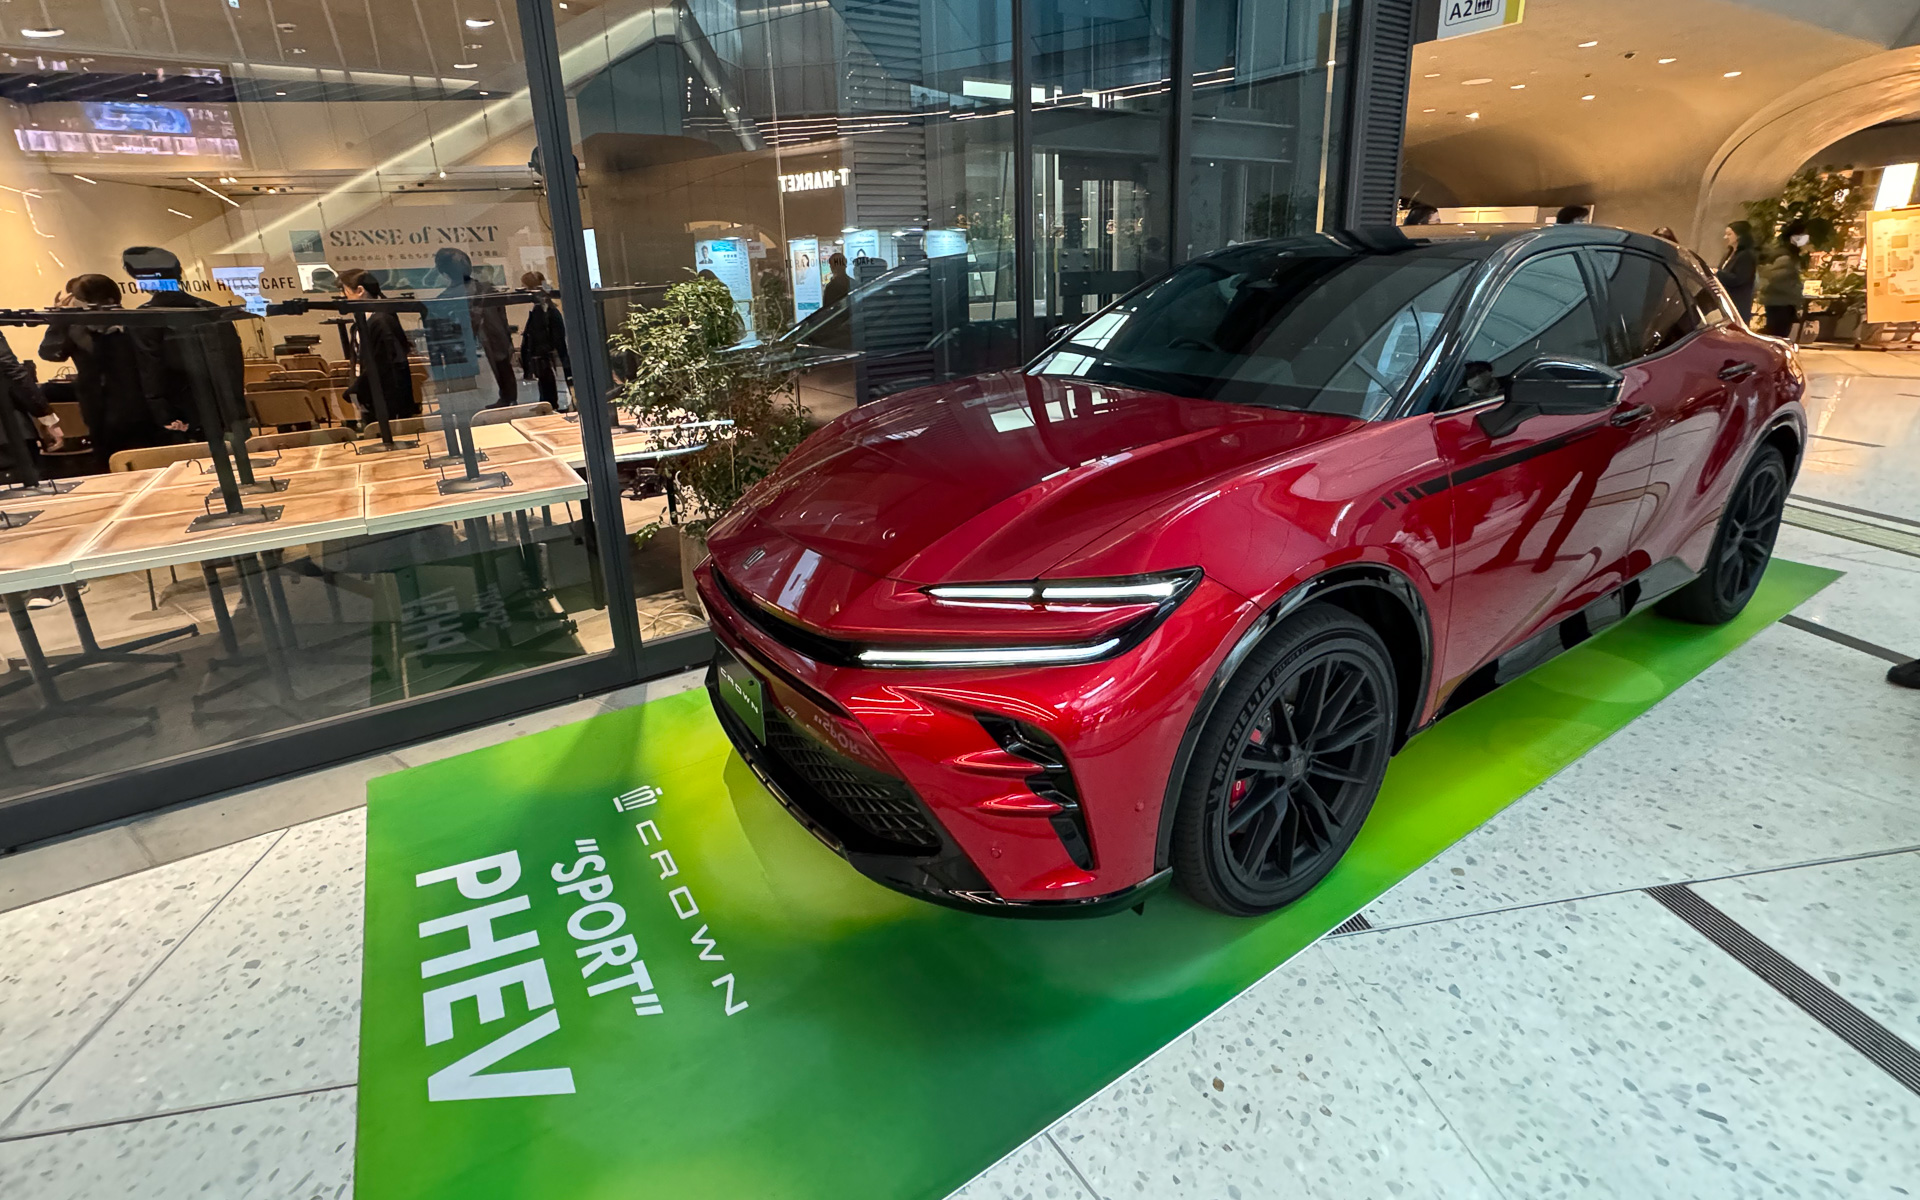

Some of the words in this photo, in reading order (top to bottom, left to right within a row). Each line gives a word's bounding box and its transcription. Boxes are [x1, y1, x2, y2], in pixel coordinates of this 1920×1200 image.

[1449, 0, 1473, 20] A2
[329, 229, 403, 247] SENSE
[409, 226, 431, 245] of
[436, 226, 499, 244] NEXT
[261, 277, 296, 290] CAFE
[720, 667, 759, 714] CROWN
[1214, 677, 1273, 782] MICHELIN
[635, 819, 749, 1017] CROWN
[415, 849, 577, 1102] PHEV
